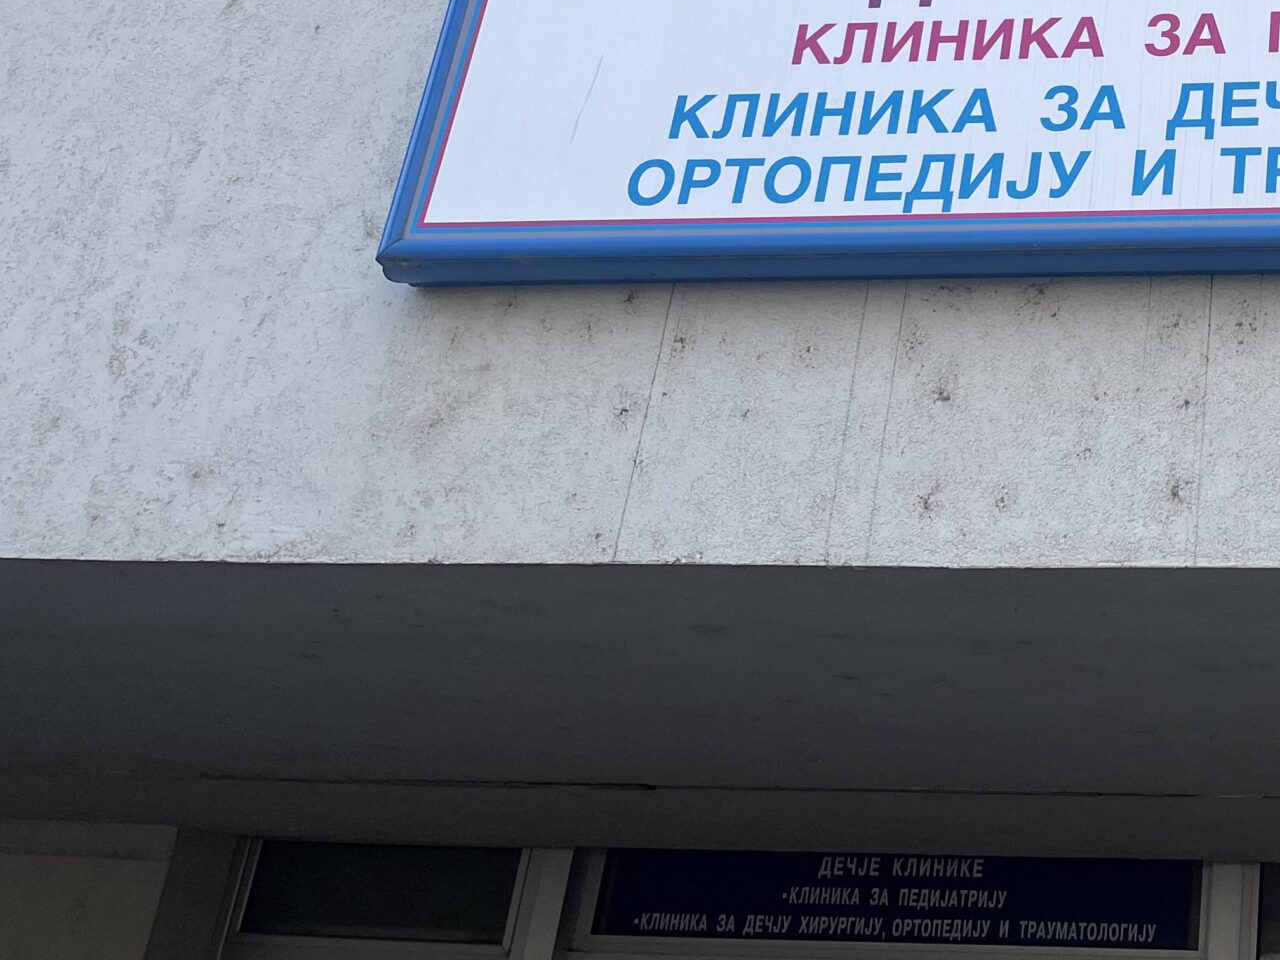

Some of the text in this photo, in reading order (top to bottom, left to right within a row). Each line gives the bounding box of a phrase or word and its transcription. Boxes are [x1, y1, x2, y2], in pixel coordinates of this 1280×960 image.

[792, 16, 1103, 65] КЛИНИКА
[1145, 13, 1225, 56] ЗА
[669, 88, 996, 139] КЛИНИКА
[1041, 85, 1125, 131] ЗА
[628, 151, 1091, 213] ОРТОПЕДИЈУ
[1132, 149, 1176, 195] И
[818, 857, 984, 878] ДЕЧЈЕ КЛИНИКЕ
[869, 888, 889, 906] ЗА
[899, 889, 1007, 910] ПЕДИЈАТРИЈУ
[716, 914, 735, 932] ЗА
[743, 915, 791, 935] ДЕЧЈУ
[798, 916, 886, 939] ХИРУРГИЈУ,
[892, 919, 990, 940] ОРТОПЕДИЈУ
[999, 920, 1009, 938] И
[1020, 920, 1156, 942] ТРАУМАТОЛОГИЈУ
